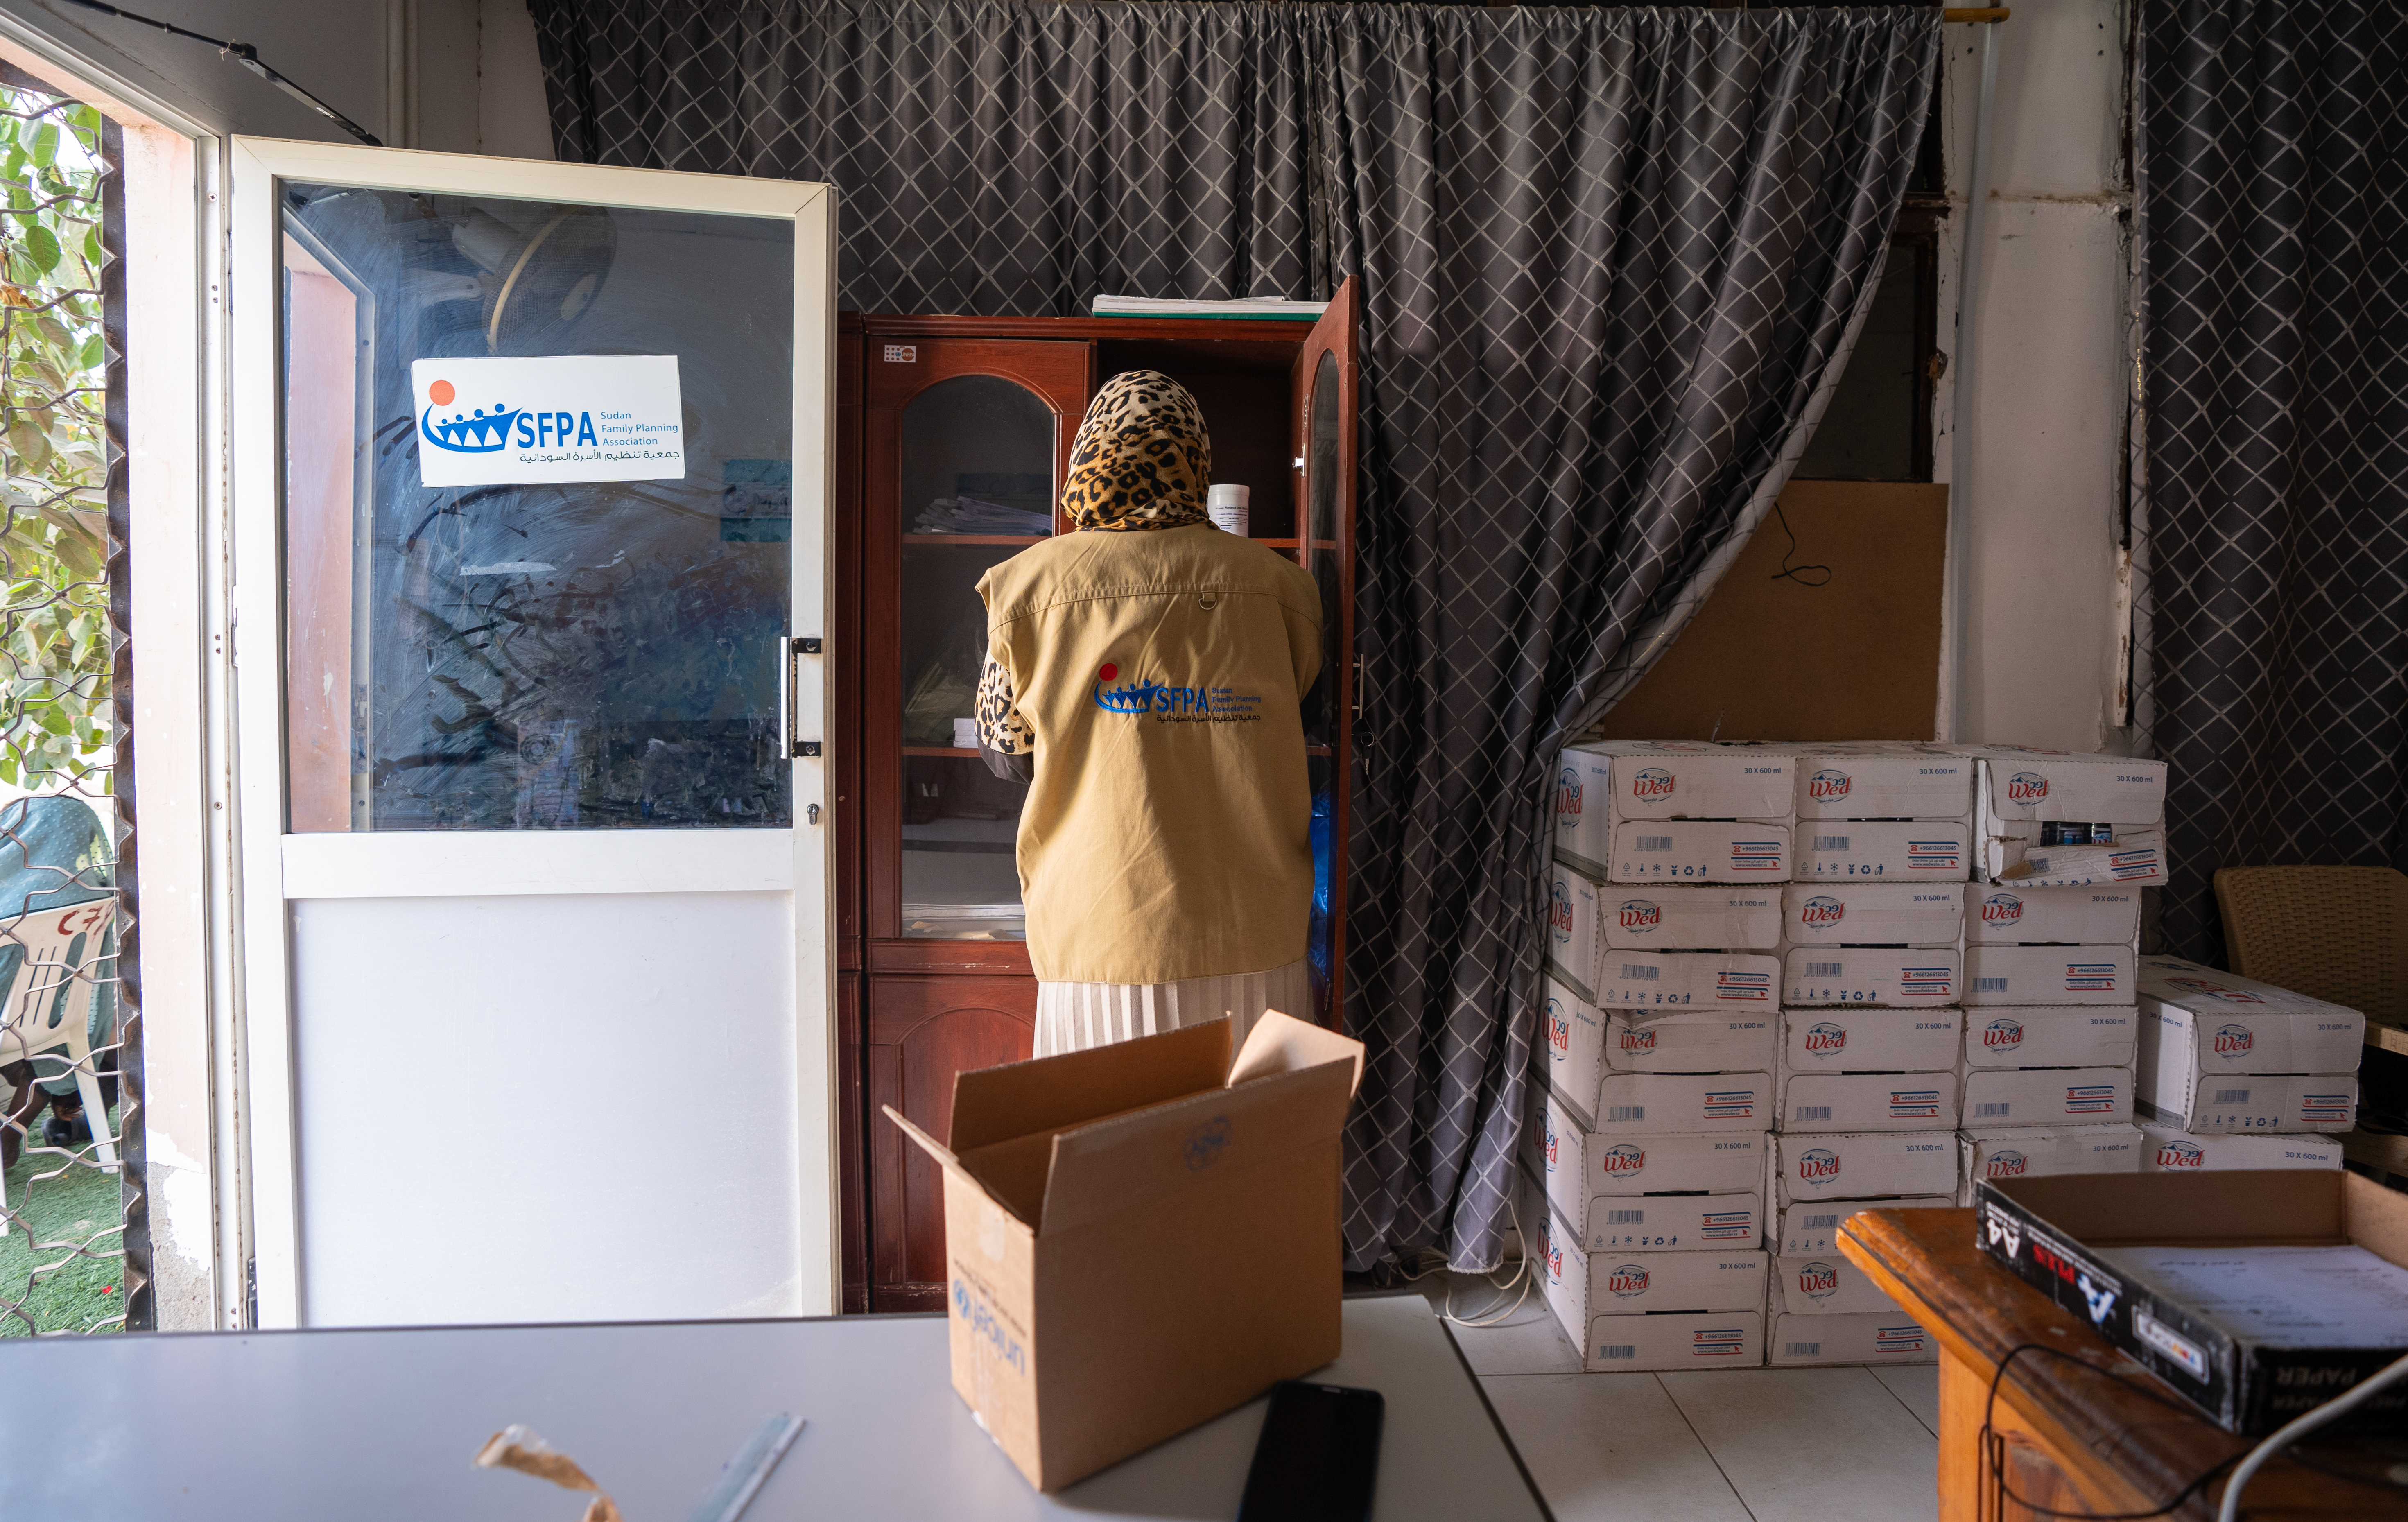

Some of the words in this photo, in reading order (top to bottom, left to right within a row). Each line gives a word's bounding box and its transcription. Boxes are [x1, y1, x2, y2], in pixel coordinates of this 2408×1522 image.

[601, 411, 631, 420] Sudan
[517, 412, 598, 448] SFPA
[601, 424, 633, 434] Family
[636, 423, 678, 433] Planning
[603, 437, 658, 446] Association
[520, 452, 571, 464] السودانية
[604, 451, 641, 461] تنظيم
[643, 450, 680, 460] جمعية
[1156, 687, 1209, 712] SFPA
[1212, 696, 1233, 704] Family
[1634, 775, 1675, 796] Wed
[1810, 777, 1851, 796] Wed
[2009, 780, 2048, 798] Wed
[1620, 907, 1660, 926] Wed
[1802, 903, 1845, 922] Wed
[1982, 901, 2024, 920] Wed
[2162, 1016, 2174, 1025] 600
[2174, 1020, 2183, 1028] ml
[1805, 1030, 1847, 1050] Wed
[1984, 1026, 2023, 1045] Wed
[2215, 1032, 2253, 1052] Wed
[1604, 1151, 1645, 1171] Wed
[1800, 1156, 1839, 1178] Wed
[1987, 1156, 2027, 1176] Wed
[2157, 1150, 2205, 1166] Wed
[1986, 1218, 2020, 1259] A4
[1609, 1272, 1650, 1291] Wed
[1800, 1269, 1836, 1292] Wed
[2276, 1366, 2358, 1386] PAPER
